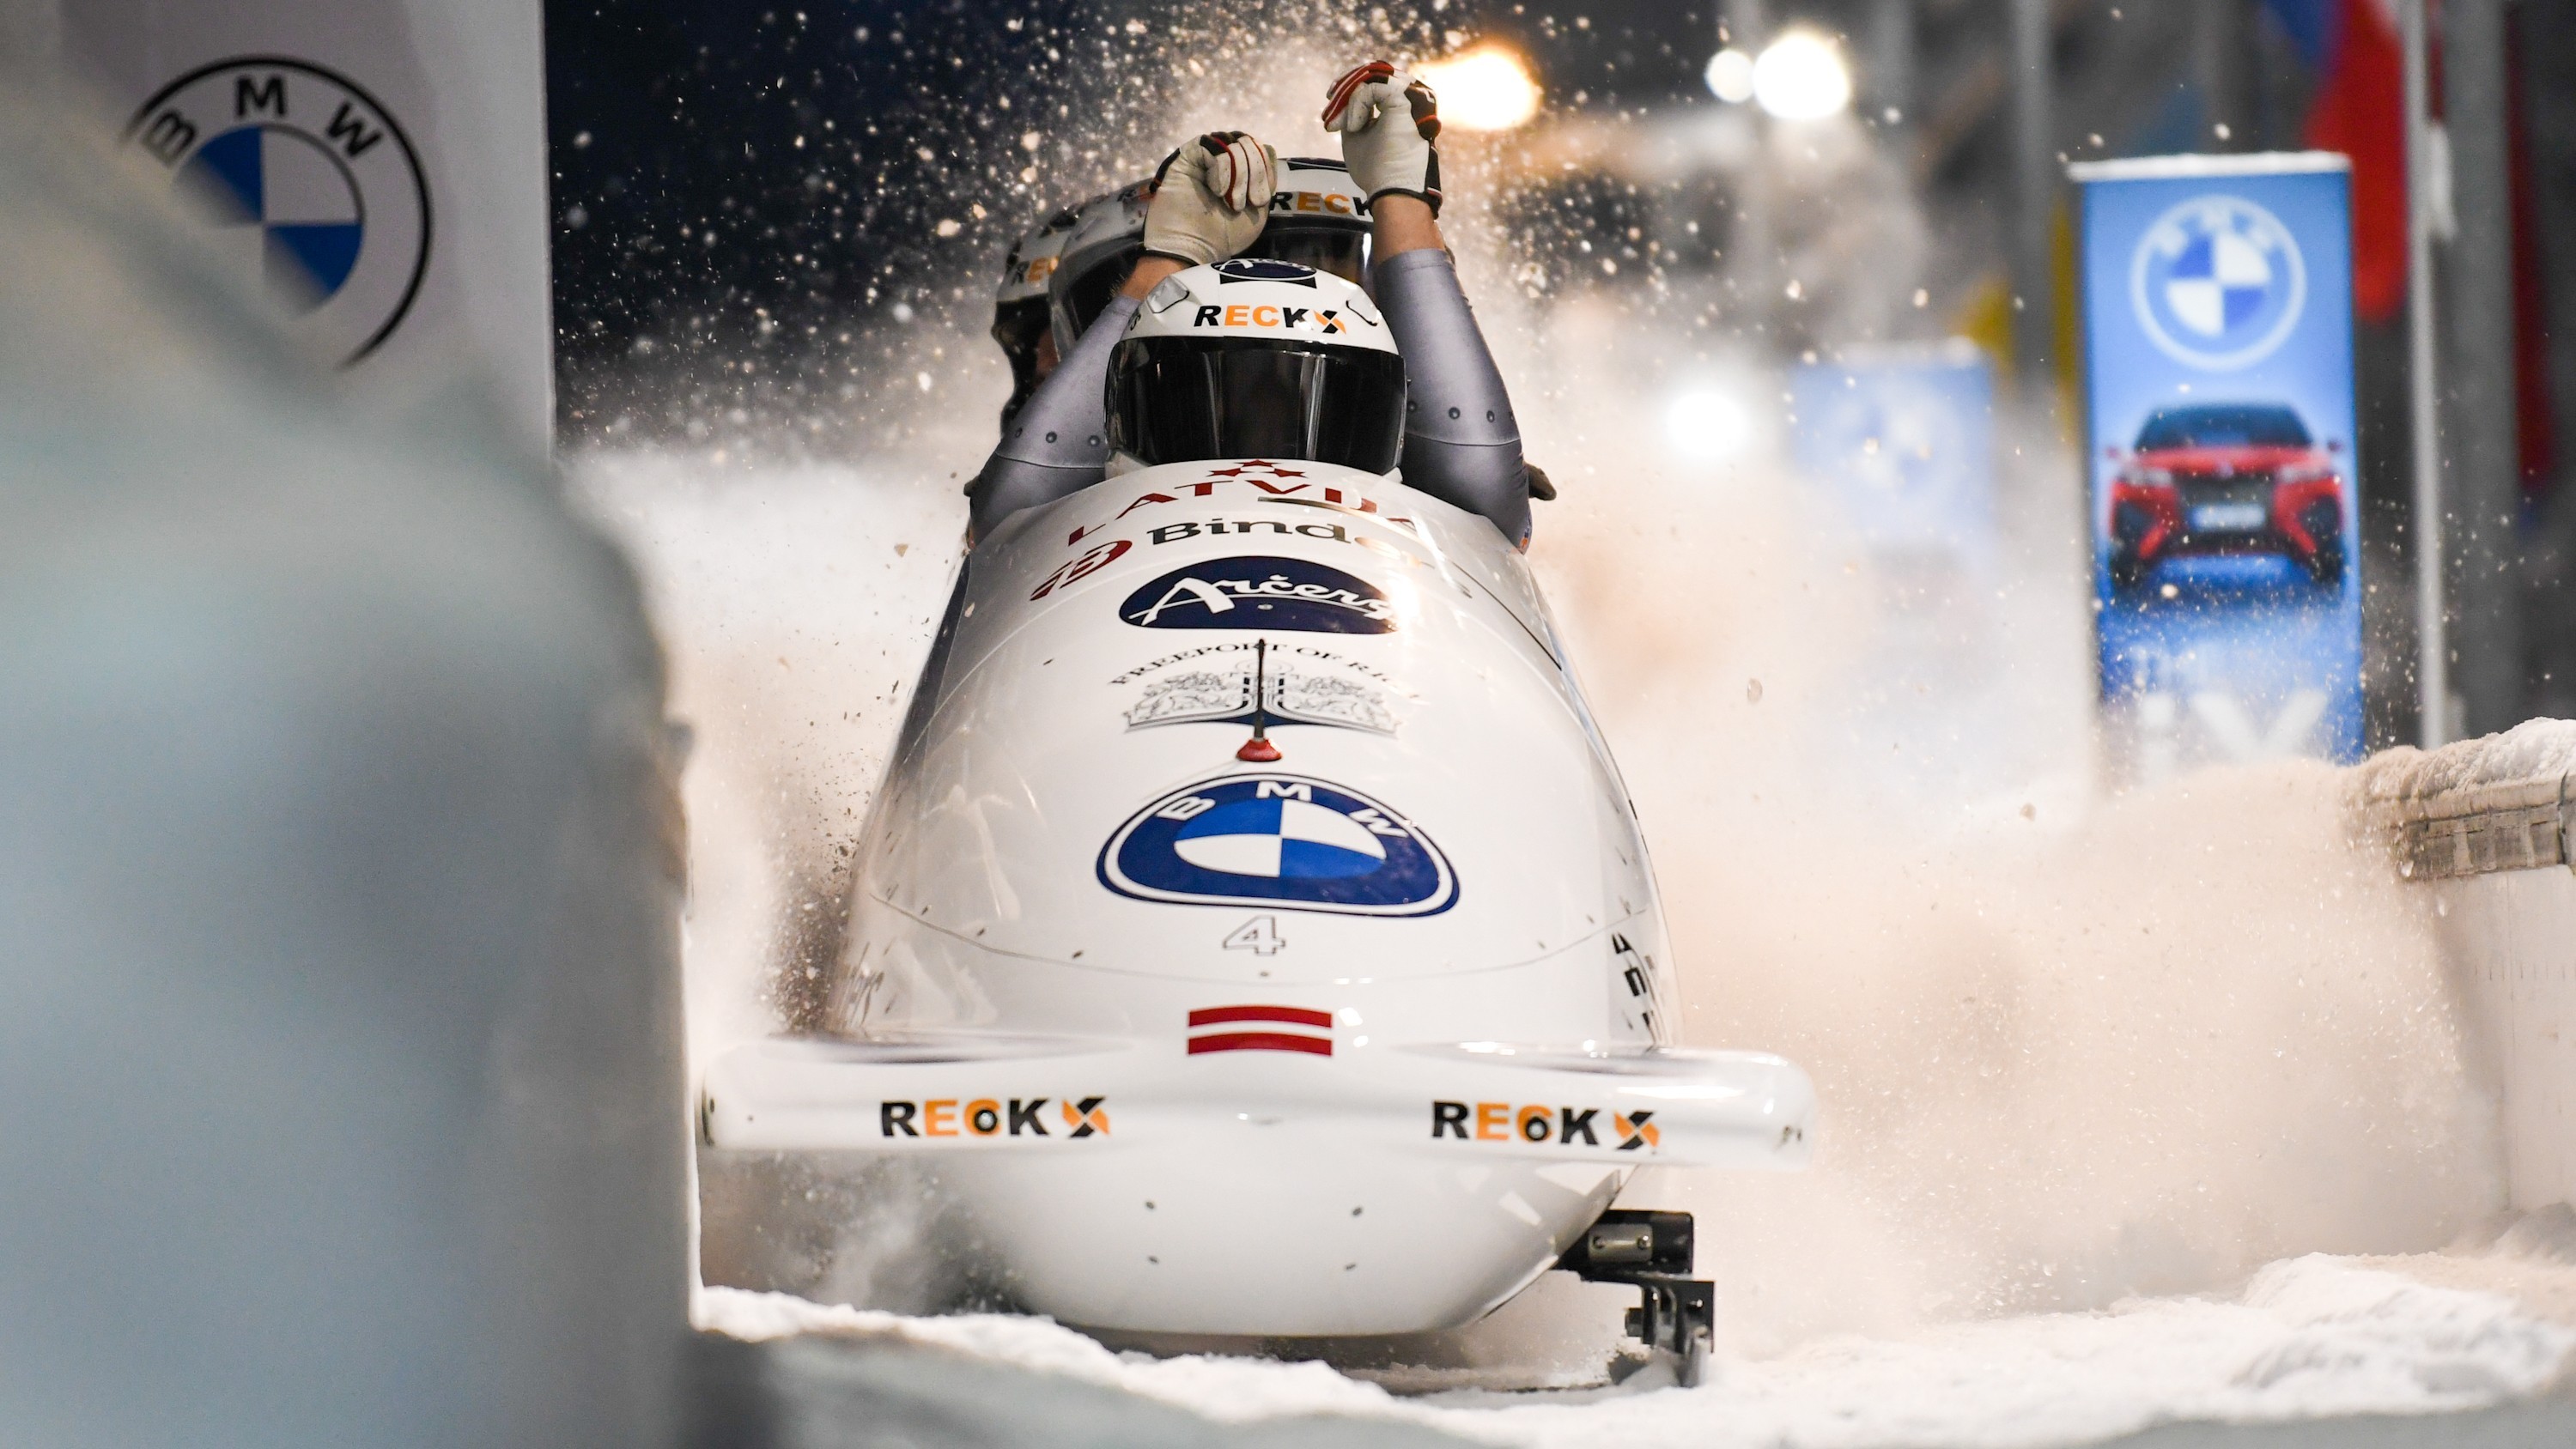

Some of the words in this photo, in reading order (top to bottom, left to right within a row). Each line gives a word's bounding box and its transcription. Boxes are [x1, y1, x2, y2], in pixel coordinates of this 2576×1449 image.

[140, 76, 384, 169] BMW
[1193, 305, 1312, 328] RECK
[1146, 518, 1437, 569] Binde
[1157, 780, 1411, 839] BMW
[1222, 914, 1286, 956] 4
